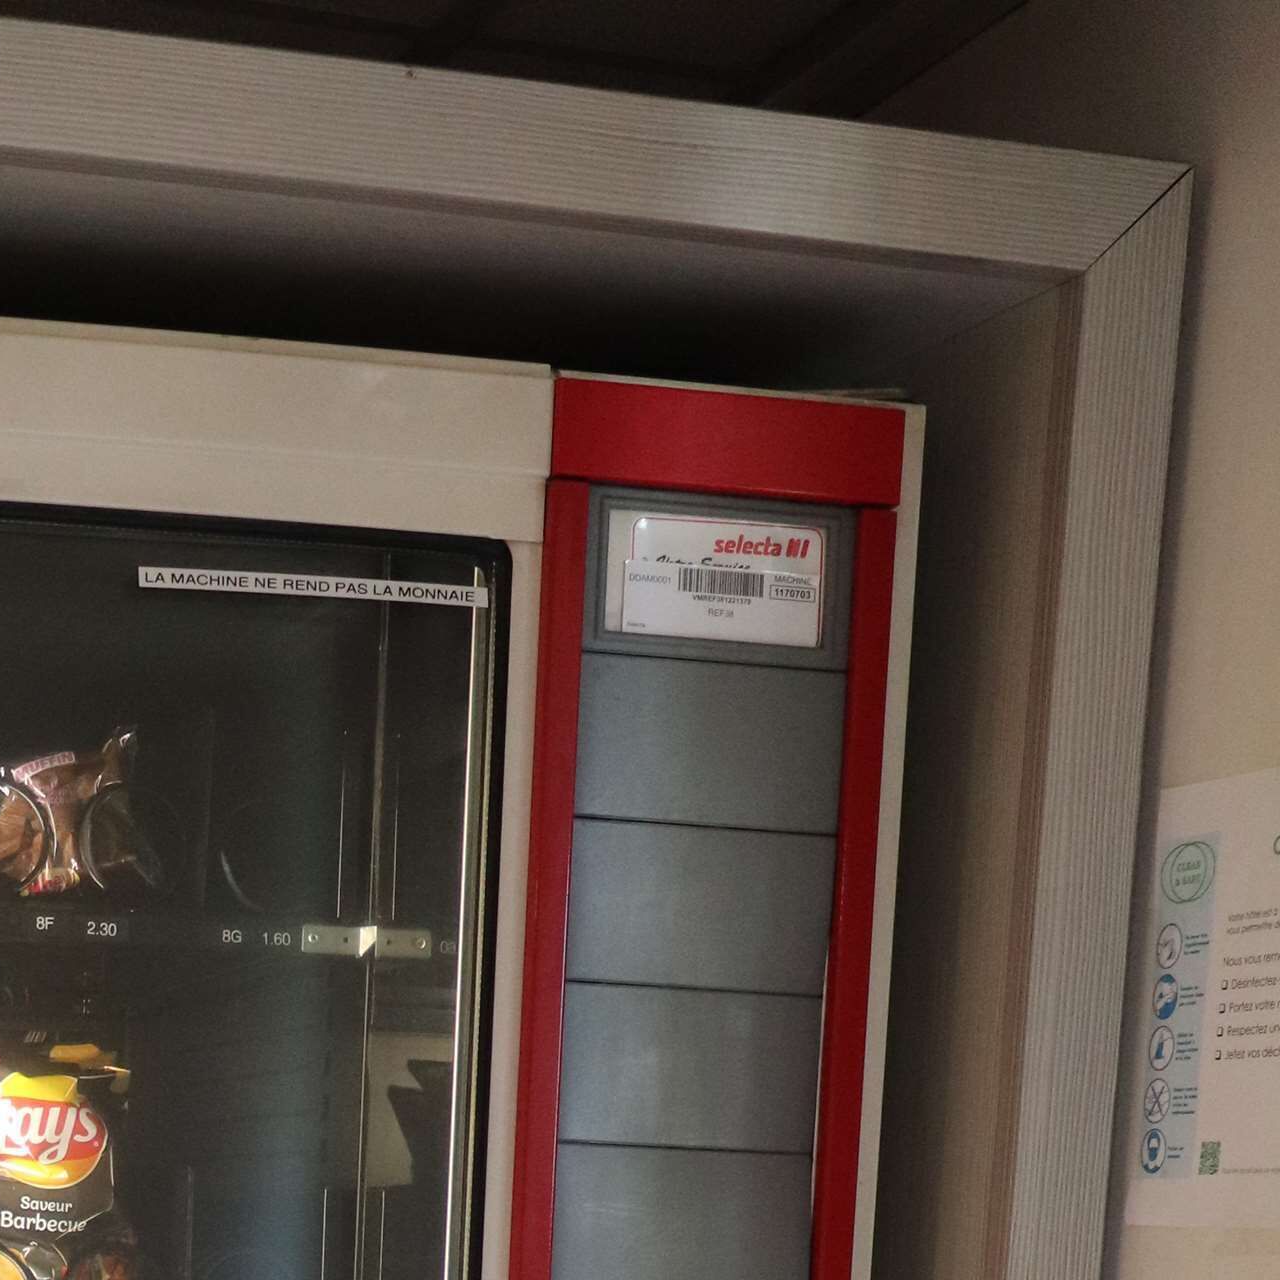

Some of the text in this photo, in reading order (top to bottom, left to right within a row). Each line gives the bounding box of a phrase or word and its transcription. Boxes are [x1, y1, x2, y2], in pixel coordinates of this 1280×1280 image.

[714, 535, 782, 557] selecta
[145, 572, 477, 603] LA MACHINE NE REND PAS LA MONNAIE
[36, 916, 117, 937] 8F 2.30
[222, 929, 291, 946] 8G 1.60
[1223, 956, 1243, 968] Nous
[1245, 954, 1260, 966] vous
[20, 1195, 73, 1213] Saveur
[0, 1210, 87, 1234] Barbecue
